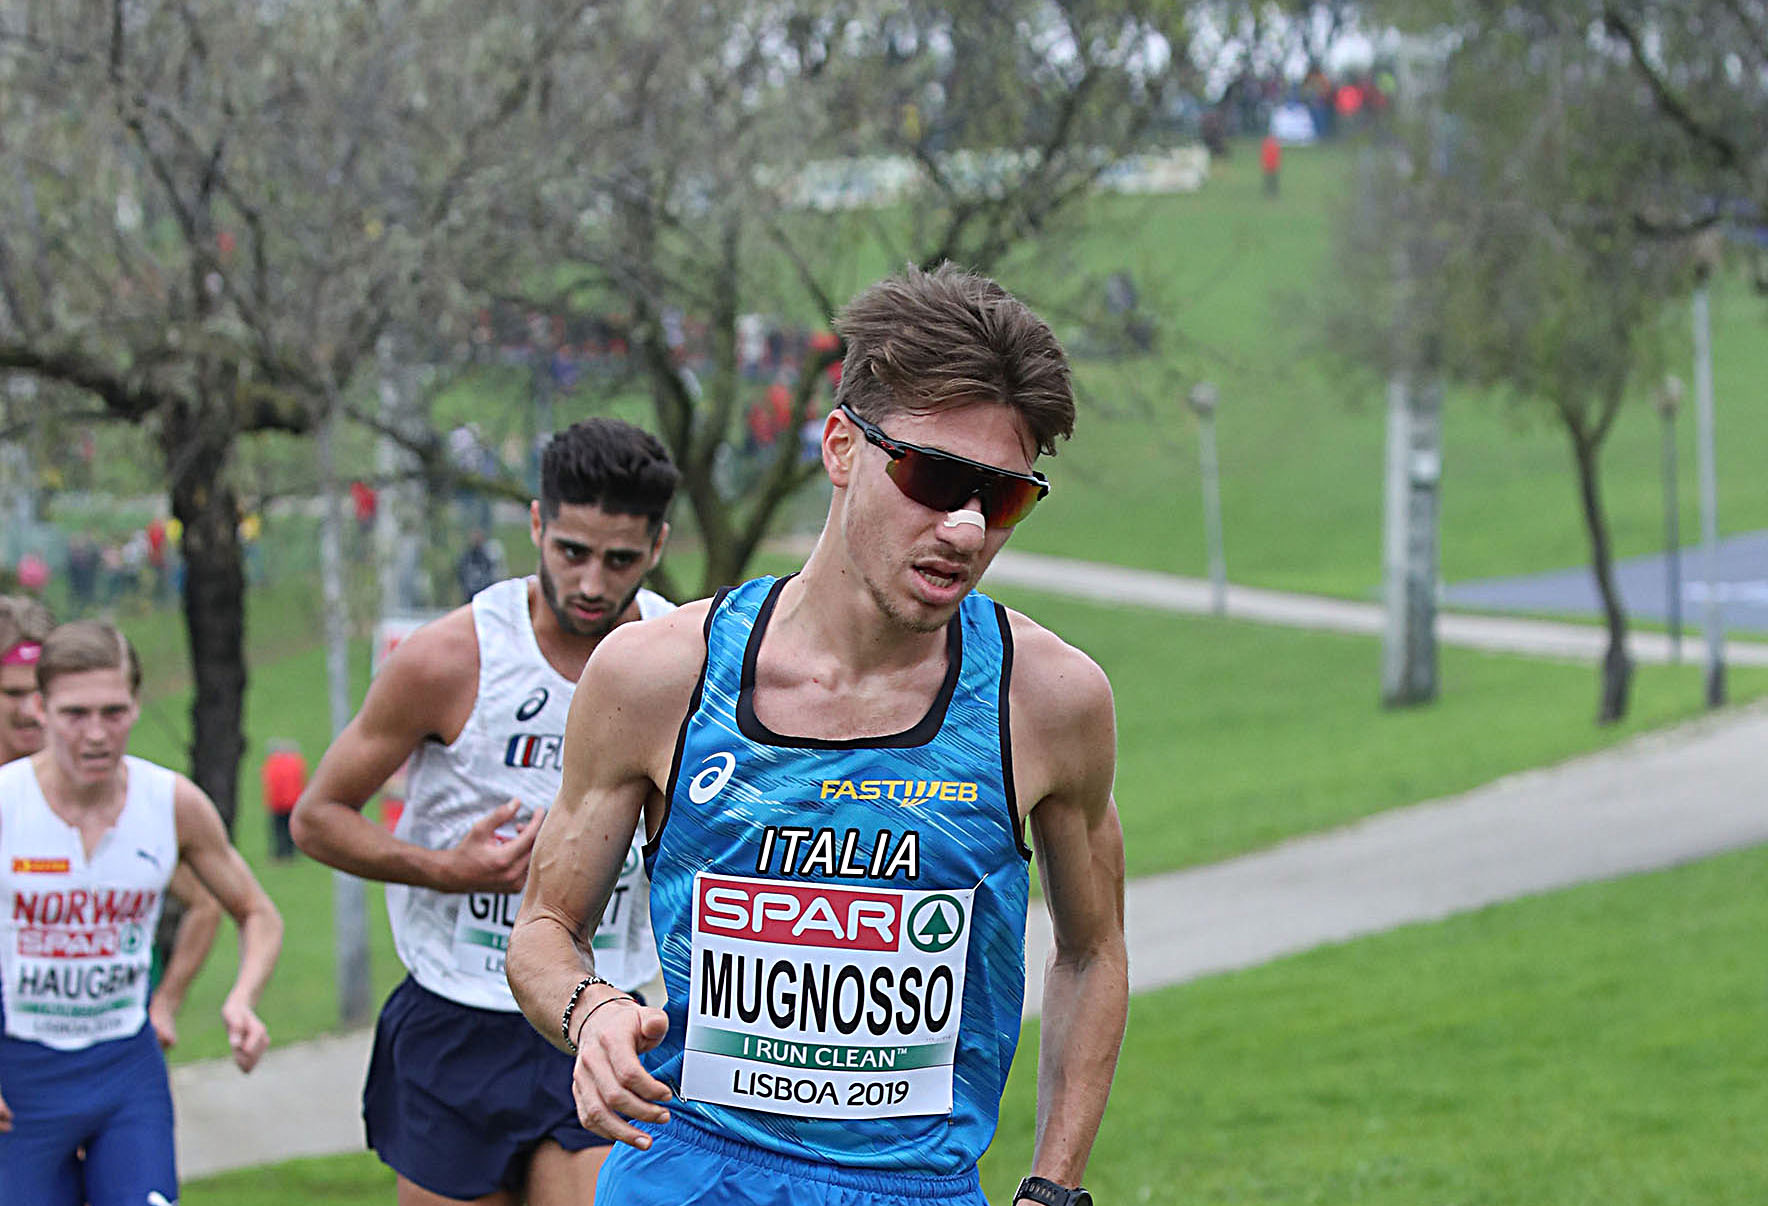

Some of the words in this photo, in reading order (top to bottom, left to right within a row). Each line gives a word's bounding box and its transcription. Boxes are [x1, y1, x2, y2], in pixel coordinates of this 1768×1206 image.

[820, 779, 978, 807] FASTWEB
[756, 826, 919, 879] ITALIA
[704, 887, 897, 943] SPAR
[700, 950, 954, 1036] MUGNOSSO
[743, 1037, 750, 1055] I
[756, 1038, 806, 1064] RUN
[732, 1070, 839, 1106] LISBOA
[847, 1081, 910, 1106] 2019
